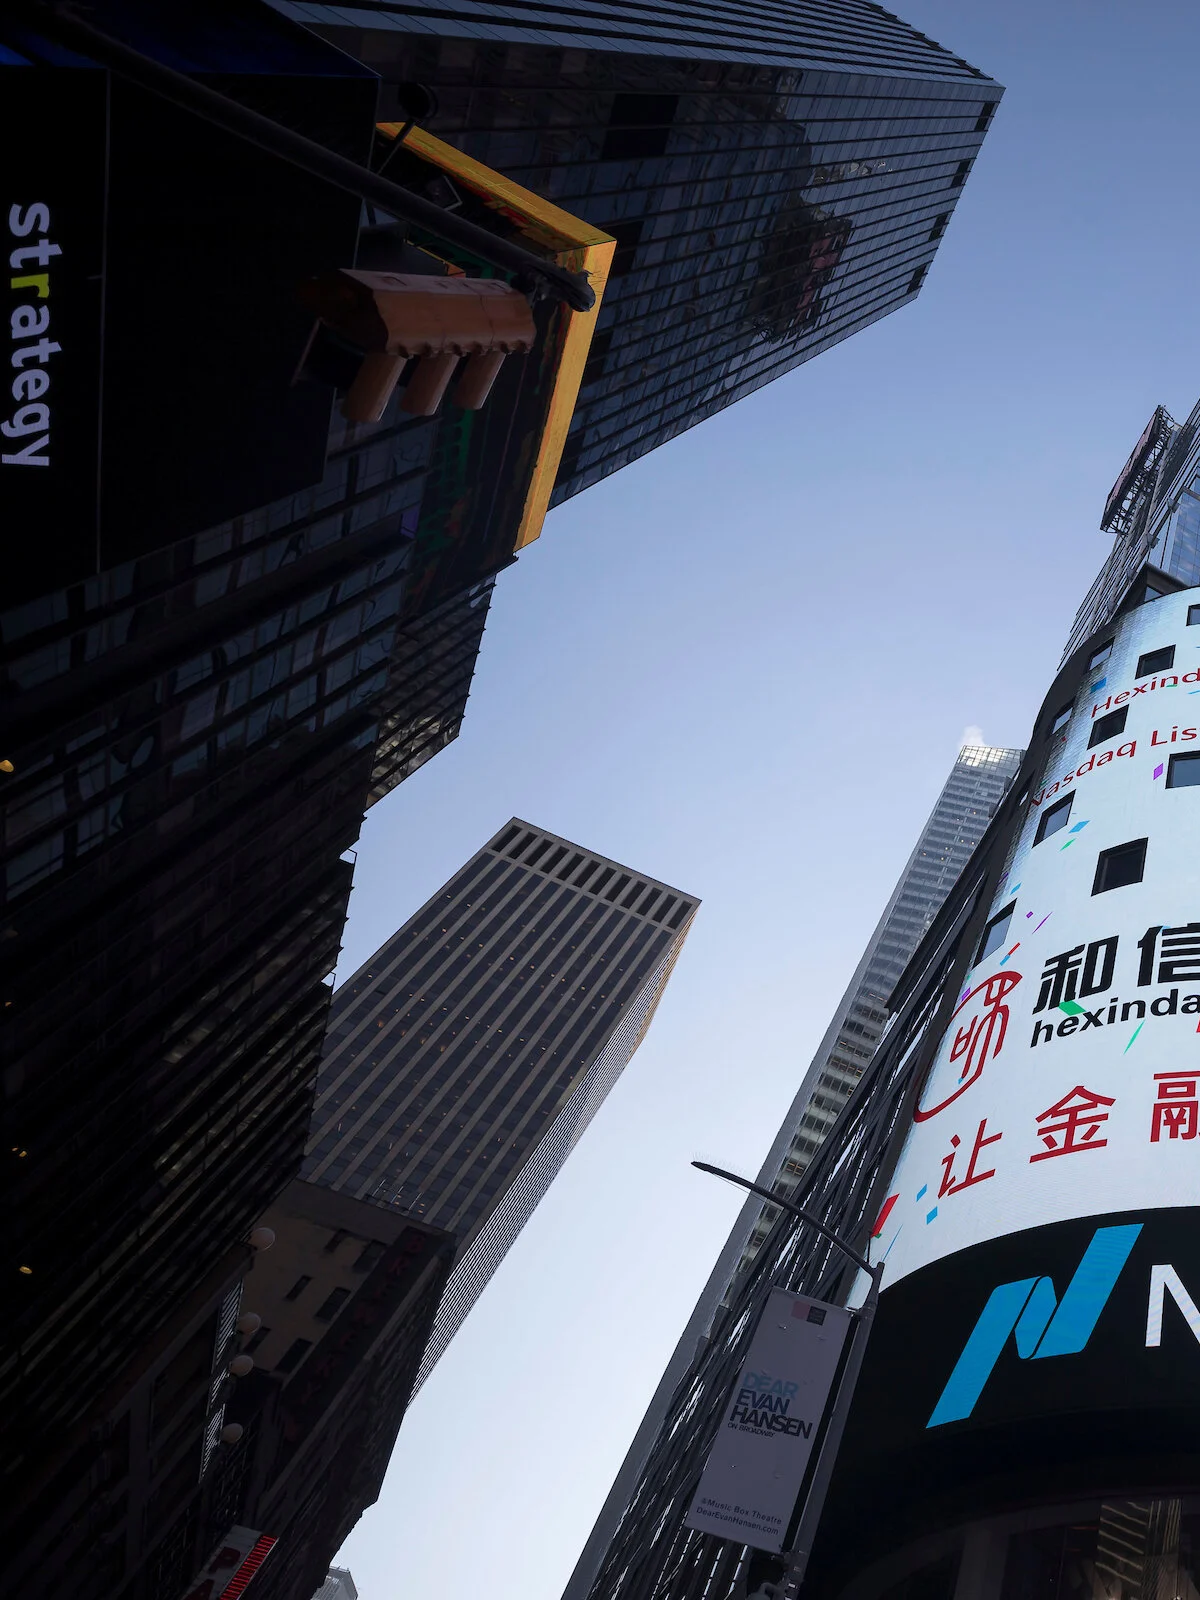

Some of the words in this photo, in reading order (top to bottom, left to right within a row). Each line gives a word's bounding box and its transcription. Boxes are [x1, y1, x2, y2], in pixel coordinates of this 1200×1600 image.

[1, 202, 63, 467] strategy
[1029, 740, 1137, 808] Nasdaq
[742, 1371, 799, 1399] DEAR
[736, 1388, 790, 1415] EVAN
[729, 1405, 813, 1439] HANSEN
[738, 1425, 776, 1438] BROADWAY
[696, 1506, 779, 1535] DearEvanHansen.com
[707, 1499, 732, 1512] Music
[733, 1505, 750, 1516] Box
[752, 1510, 782, 1525] Theatre
